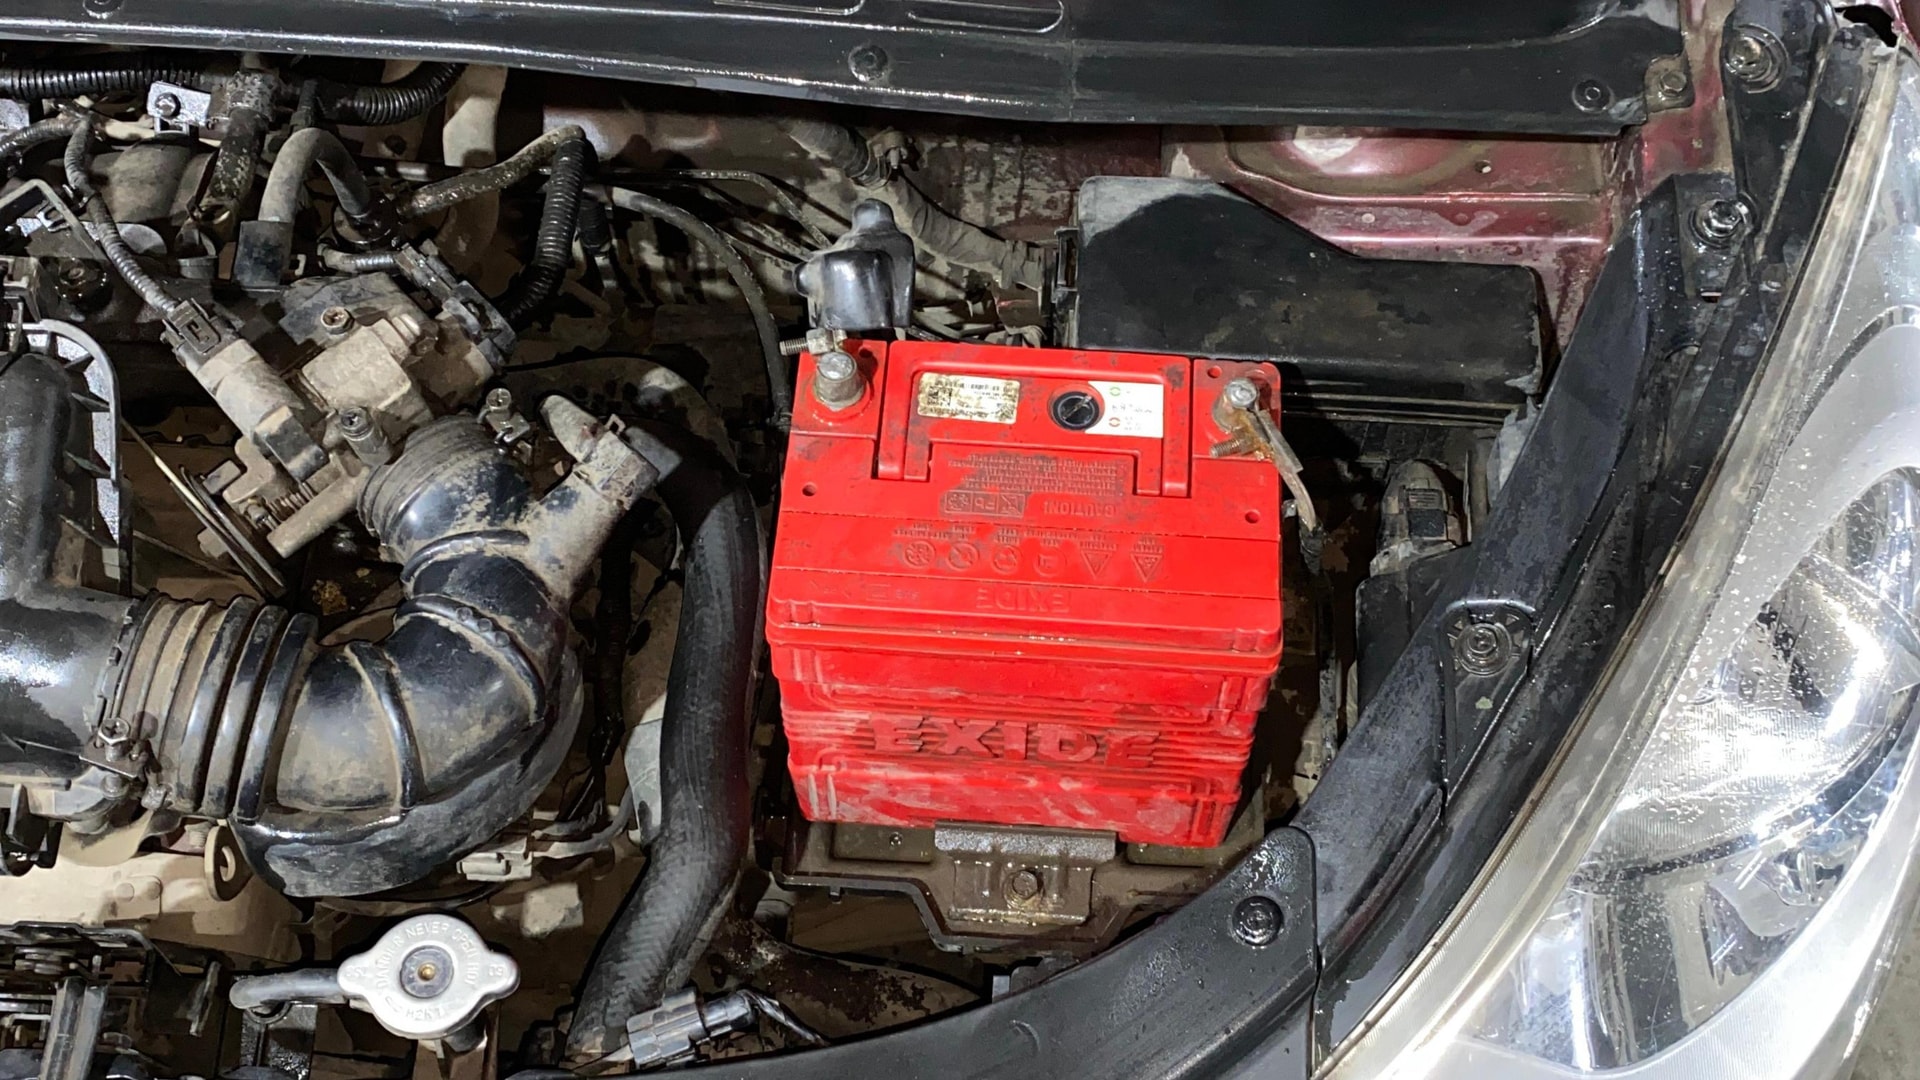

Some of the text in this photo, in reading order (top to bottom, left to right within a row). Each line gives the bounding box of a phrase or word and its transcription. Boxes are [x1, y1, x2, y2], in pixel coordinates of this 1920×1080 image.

[975, 587, 1070, 614] EXIDE
[868, 713, 1162, 768] EXIDE
[405, 921, 450, 940] NEVER
